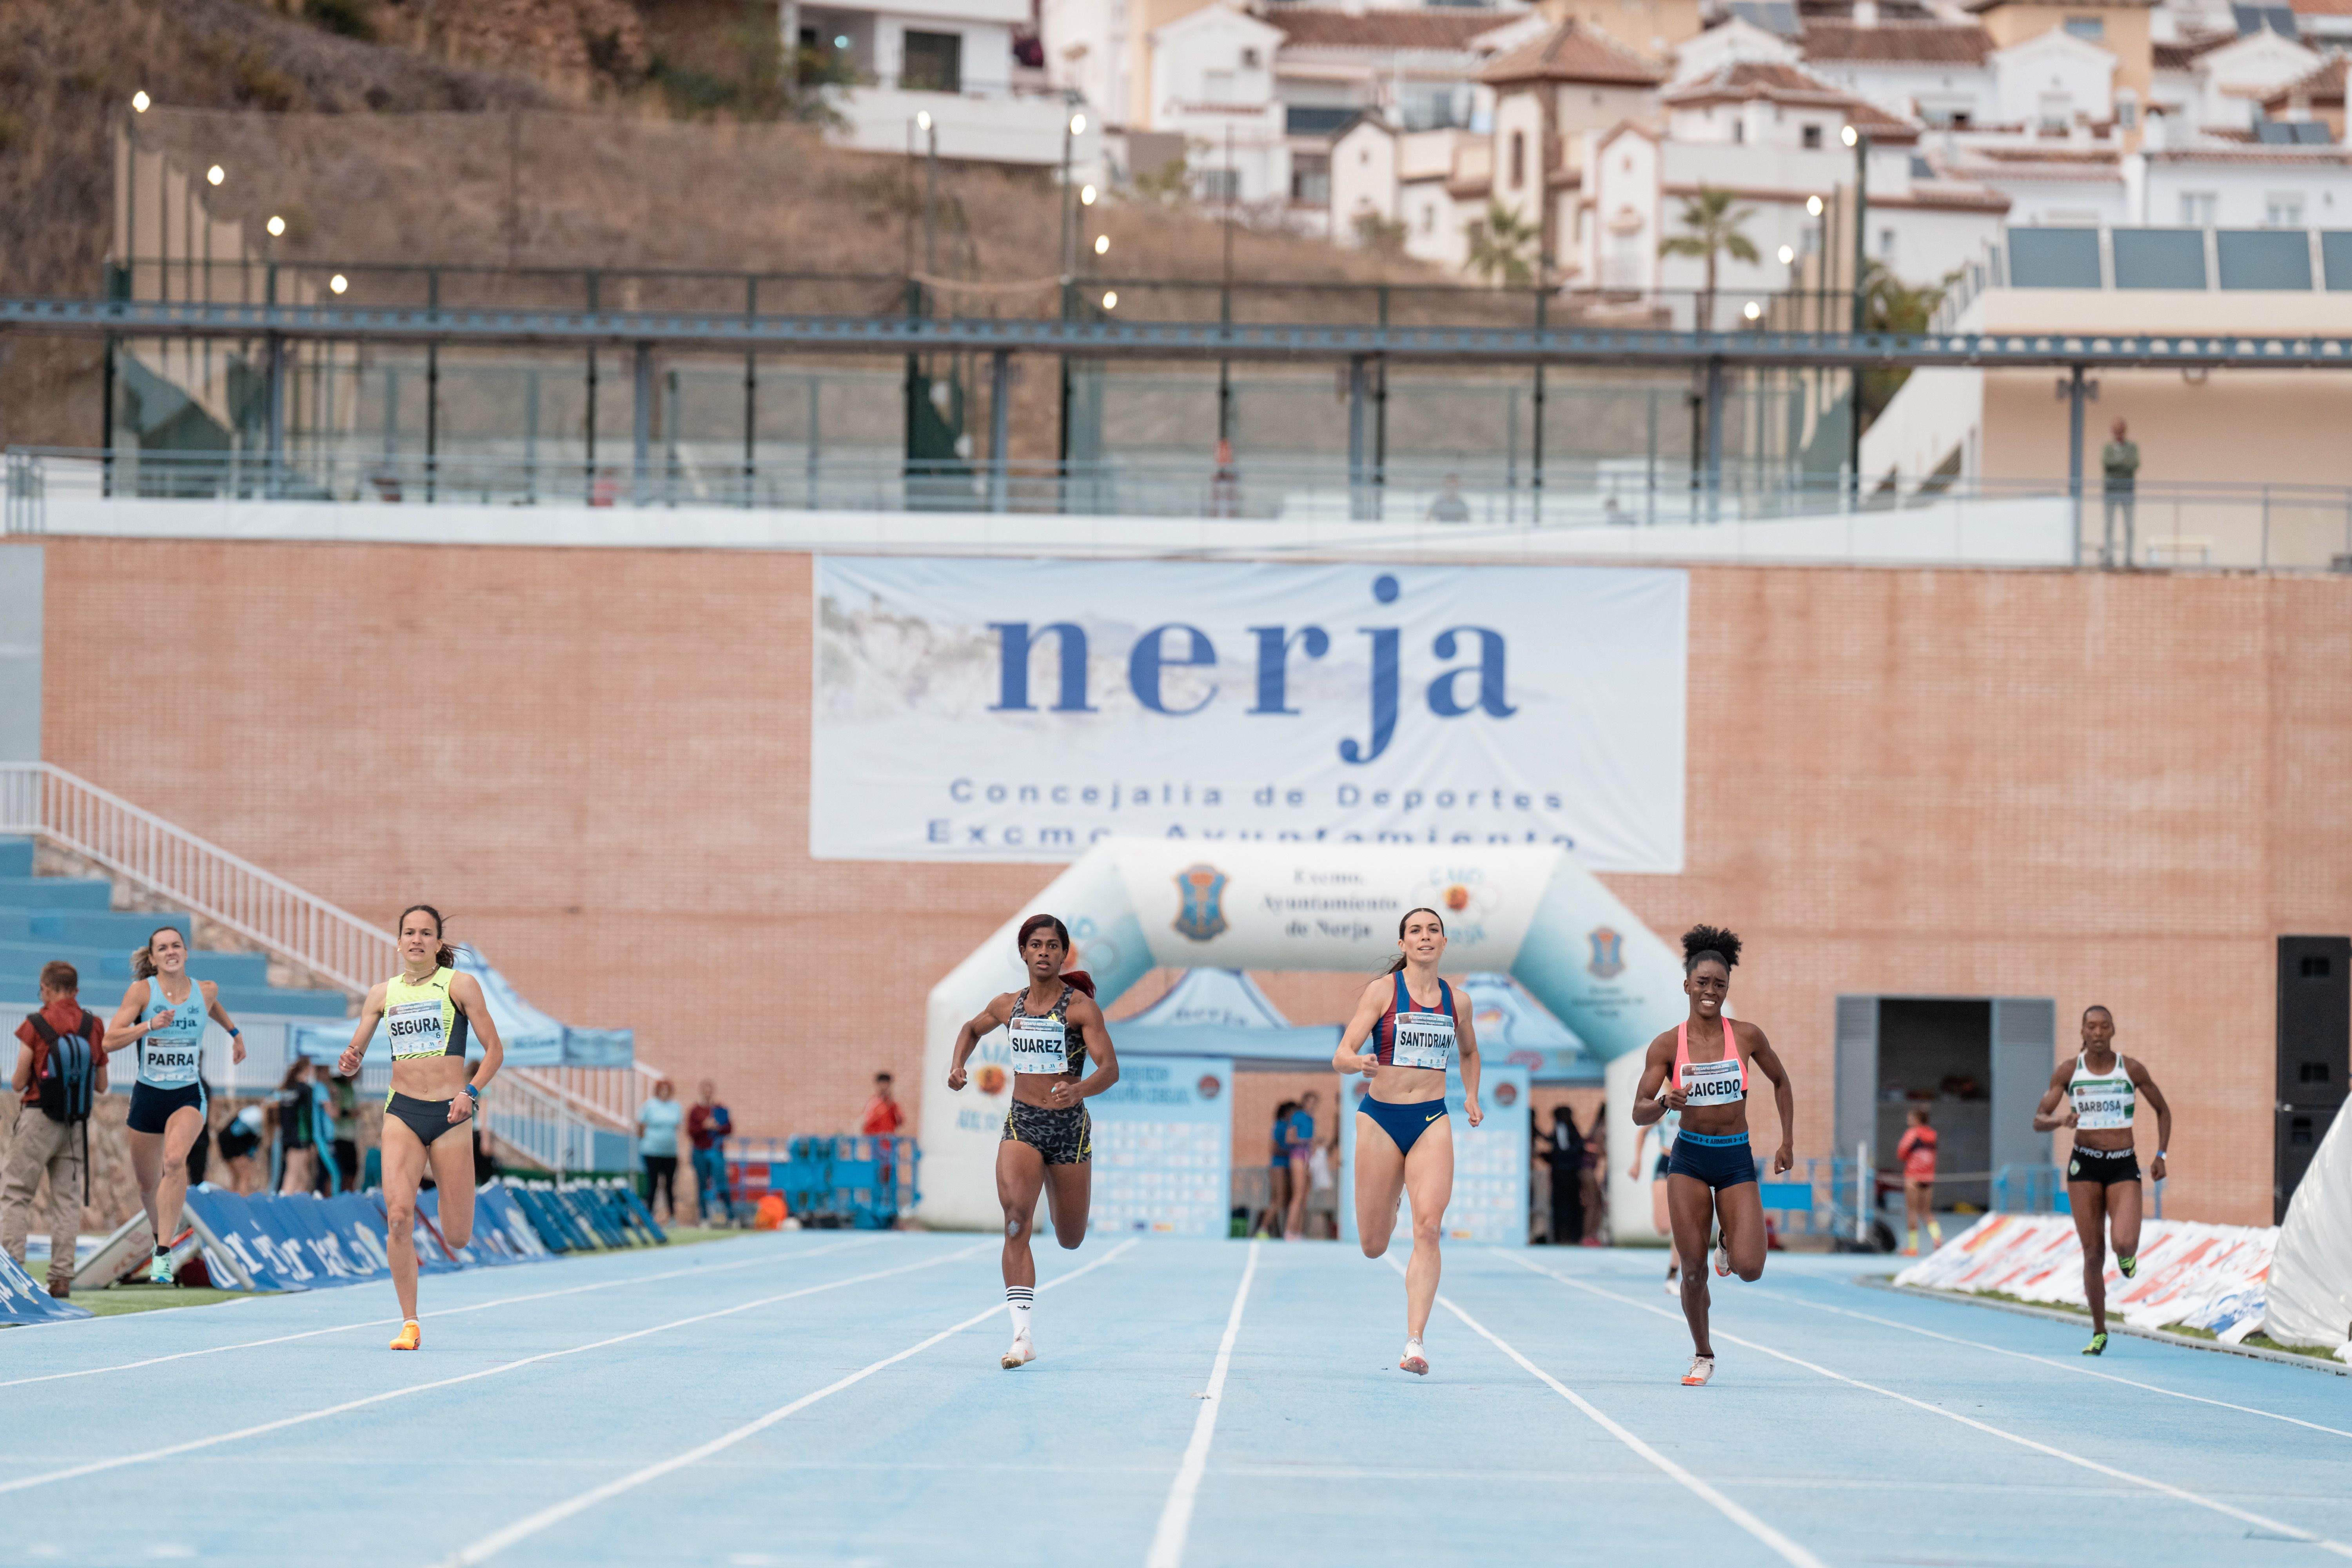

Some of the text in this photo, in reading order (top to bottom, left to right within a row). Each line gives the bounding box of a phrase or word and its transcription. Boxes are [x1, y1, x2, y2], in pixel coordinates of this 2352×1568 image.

[986, 573, 1519, 764] nerja
[1254, 785, 1304, 808] de
[1338, 784, 1562, 812] Deportes
[391, 1018, 441, 1036] SEGURA
[1013, 1038, 1062, 1053] SUAREZ
[1401, 1031, 1452, 1049] SANTIDRIAN
[148, 1053, 194, 1065] PARRA
[2078, 1100, 2121, 1112] BARBOSA
[2080, 1146, 2104, 1158] PRO
[2106, 1148, 2132, 1159] NIKE
